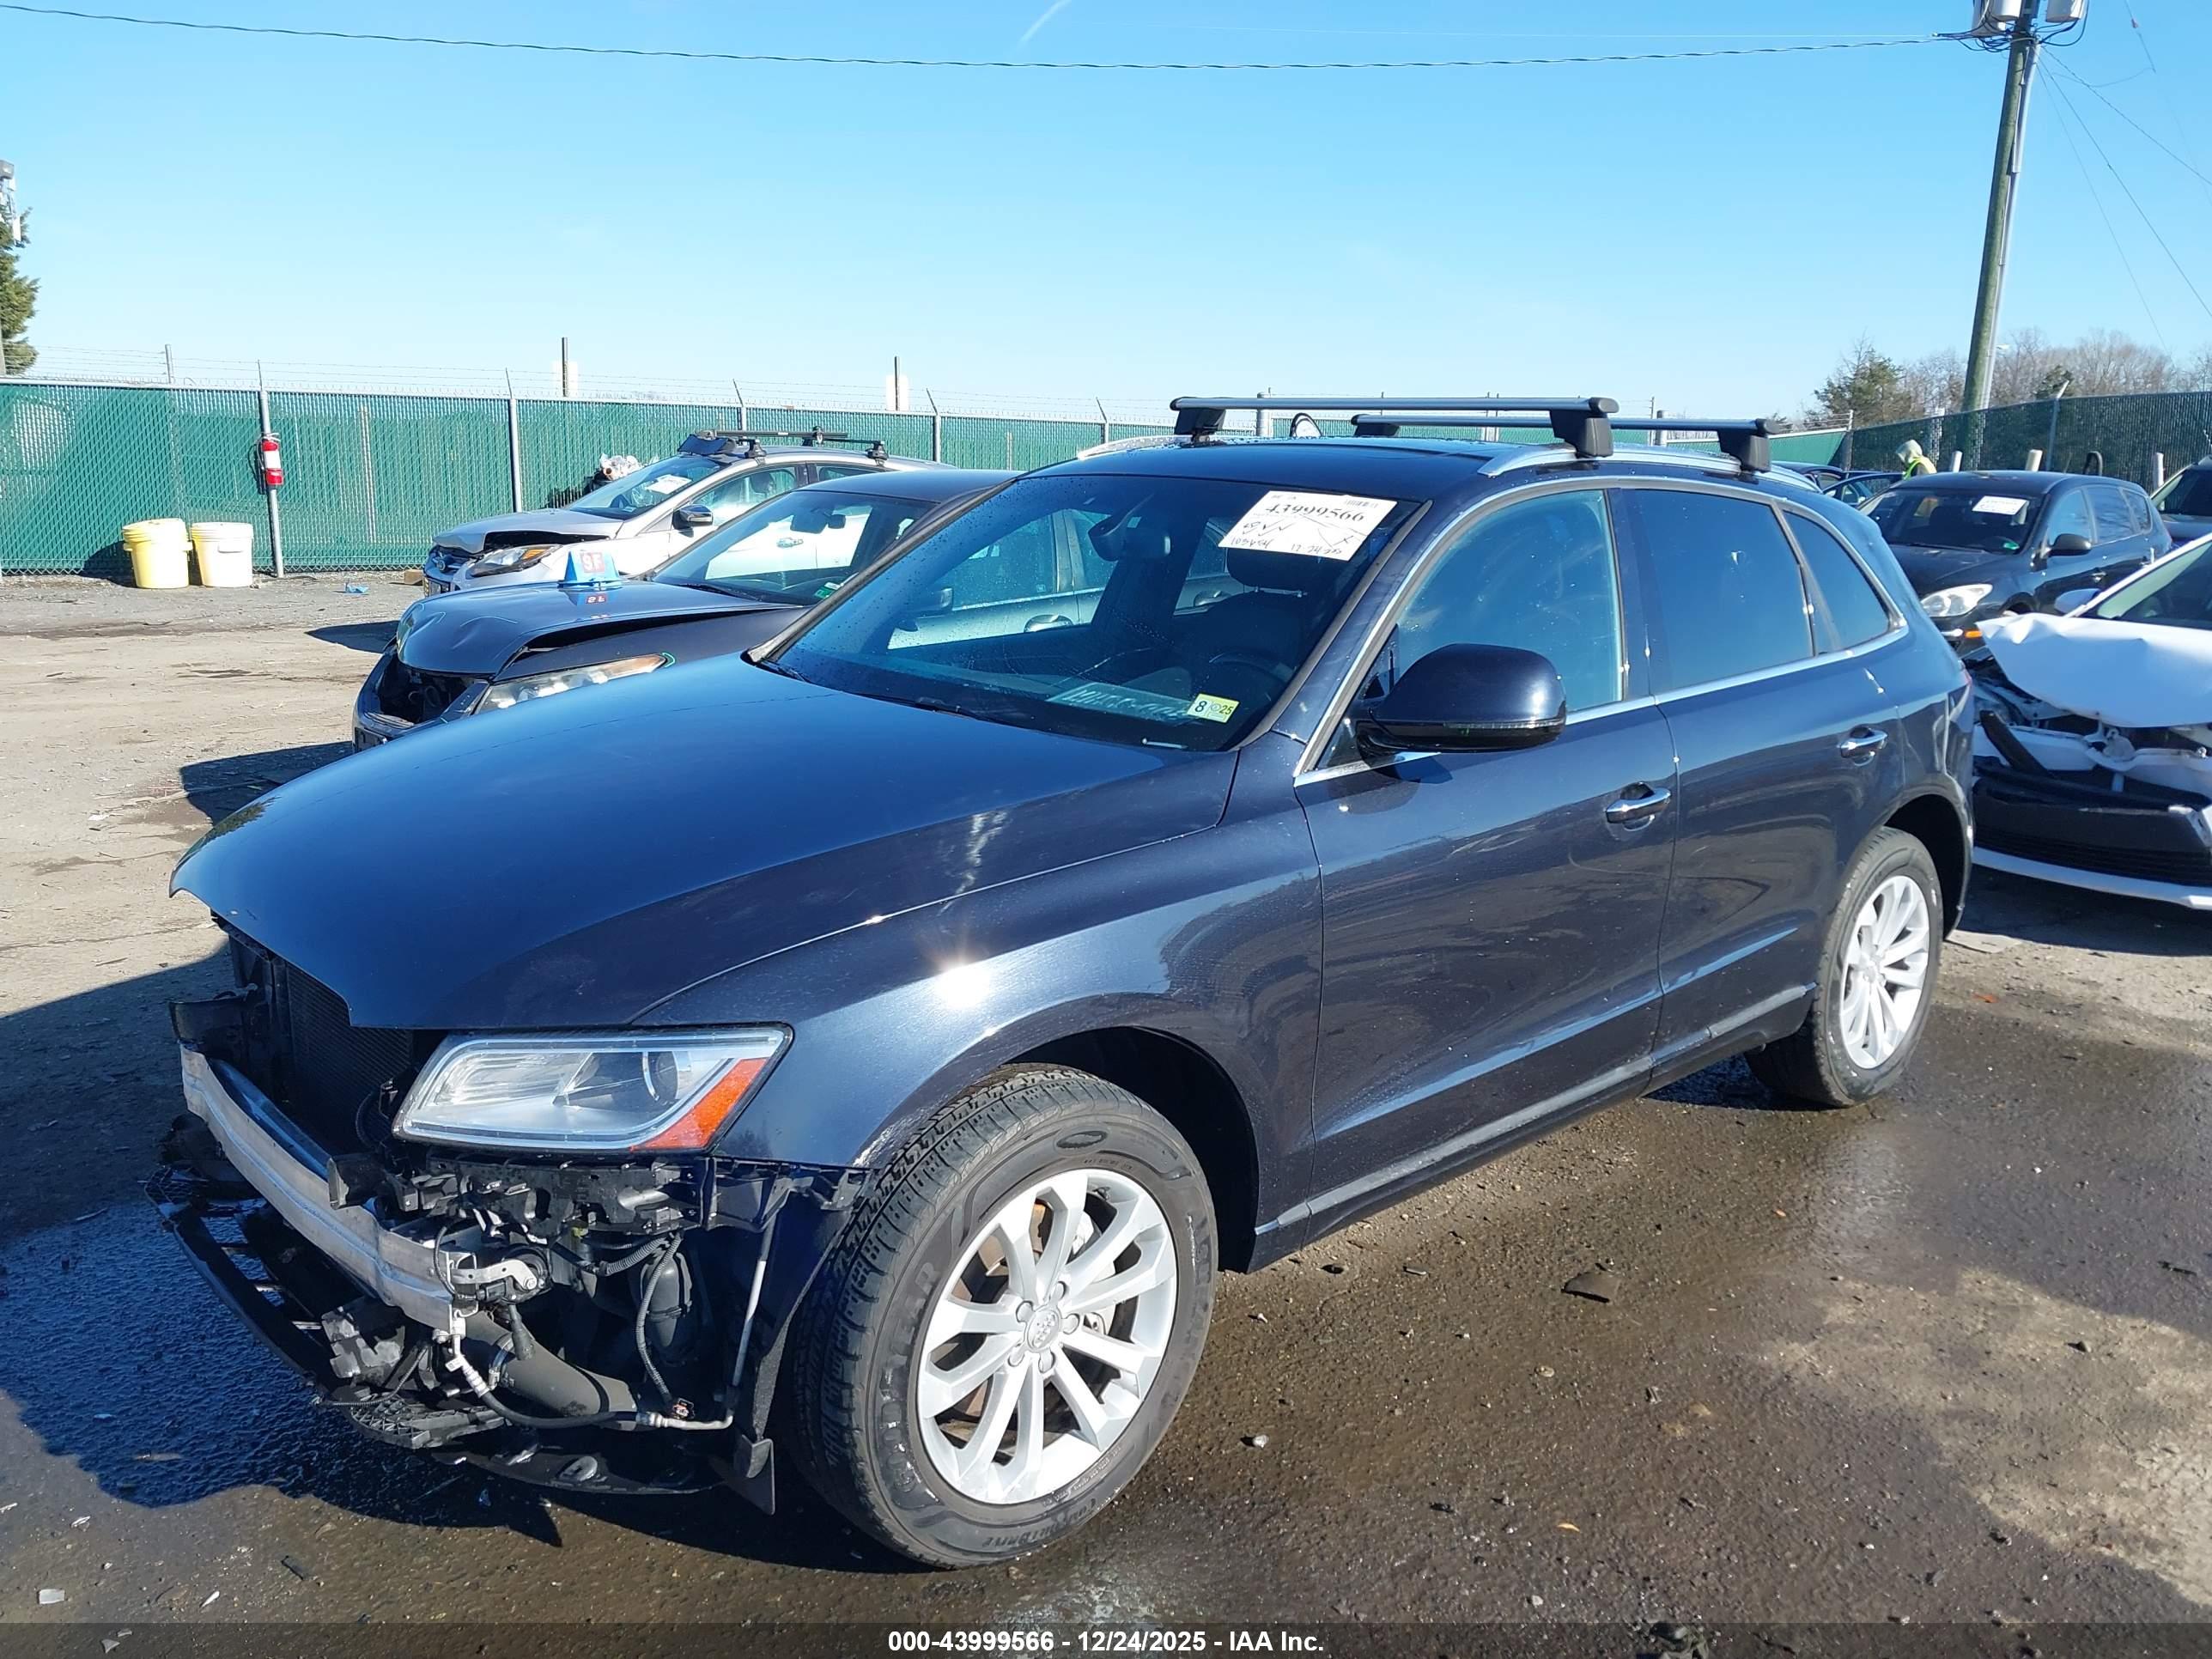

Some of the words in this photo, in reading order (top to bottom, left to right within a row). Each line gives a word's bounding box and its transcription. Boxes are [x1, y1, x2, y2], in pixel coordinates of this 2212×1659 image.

[582, 554, 602, 571] 9F
[1194, 701, 1207, 713] 8
[1218, 704, 1234, 714] 25
